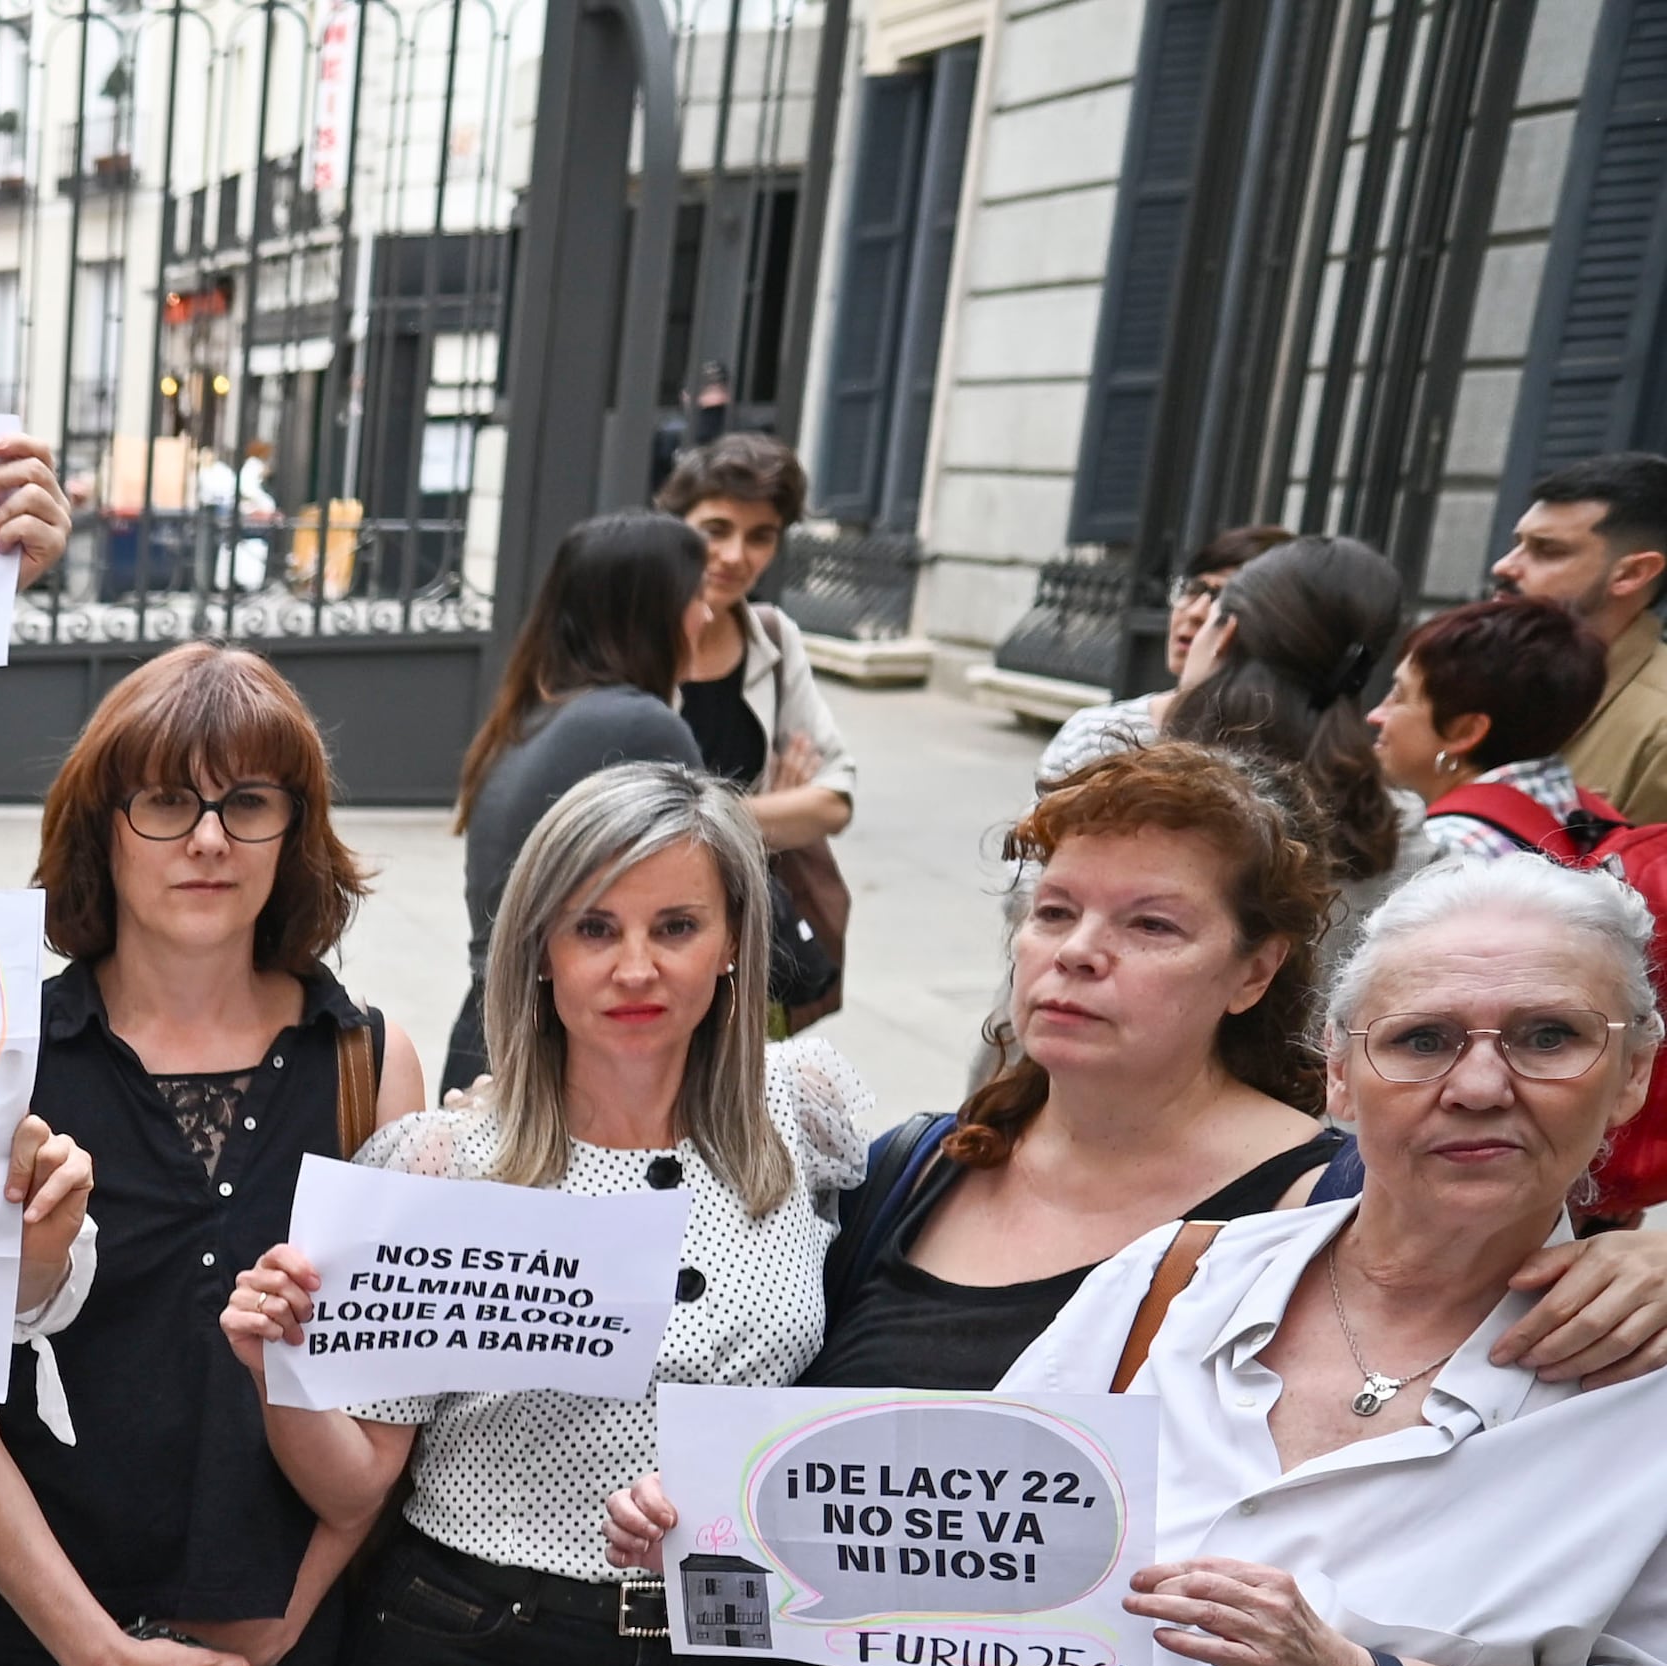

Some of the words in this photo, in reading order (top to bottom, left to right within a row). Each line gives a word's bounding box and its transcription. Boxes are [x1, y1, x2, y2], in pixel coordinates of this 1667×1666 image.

[377, 1245, 452, 1269] NOS
[461, 1248, 579, 1278] ESTÁN
[350, 1272, 593, 1308] FULMINANDO
[310, 1302, 436, 1323] LOQUE
[444, 1304, 465, 1320] A
[476, 1304, 630, 1334] BLOQUE,
[309, 1329, 438, 1355] BARRIO
[446, 1330, 467, 1348] A
[478, 1331, 613, 1357] BARRIO
[788, 1463, 865, 1499] ¡DE
[880, 1466, 1008, 1501] LACY
[1022, 1471, 1095, 1508] 22,
[824, 1504, 892, 1536] NO
[905, 1508, 963, 1541] SE
[977, 1511, 1044, 1544] VA
[837, 1545, 885, 1573] NI
[899, 1548, 1035, 1583] DIOS!
